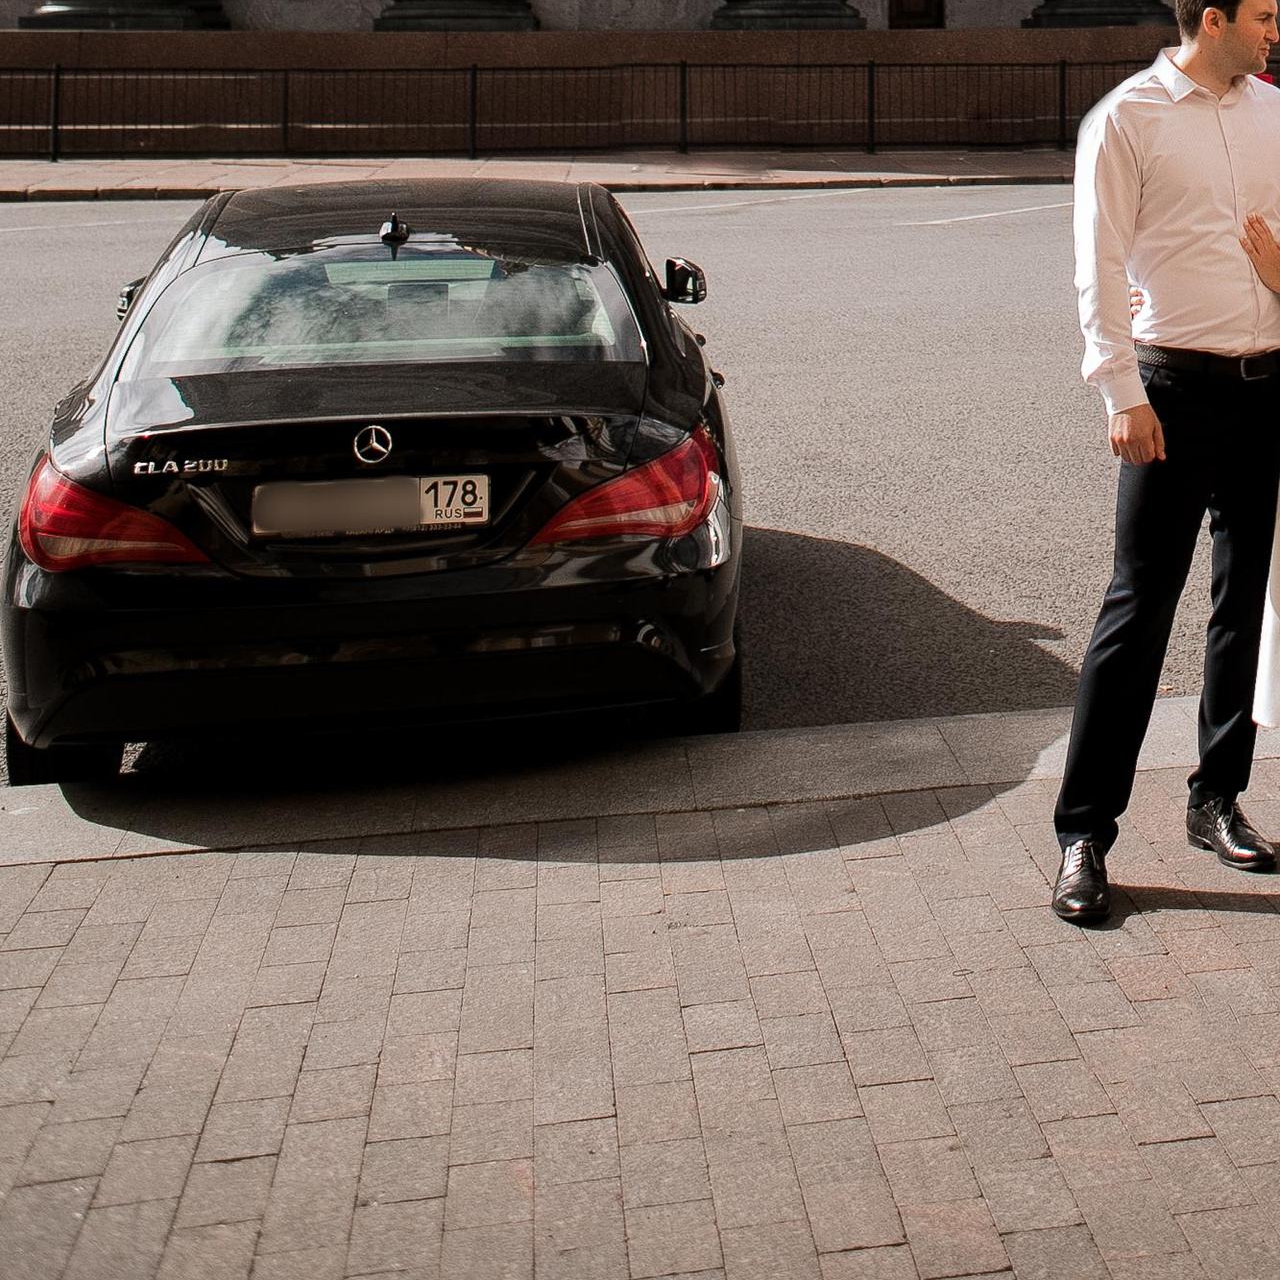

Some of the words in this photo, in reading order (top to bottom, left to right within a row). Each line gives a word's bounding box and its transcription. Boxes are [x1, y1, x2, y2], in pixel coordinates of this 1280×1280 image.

[133, 460, 180, 474] CLA
[183, 459, 229, 473] 200
[424, 479, 478, 508] 178
[434, 508, 462, 519] RUS
